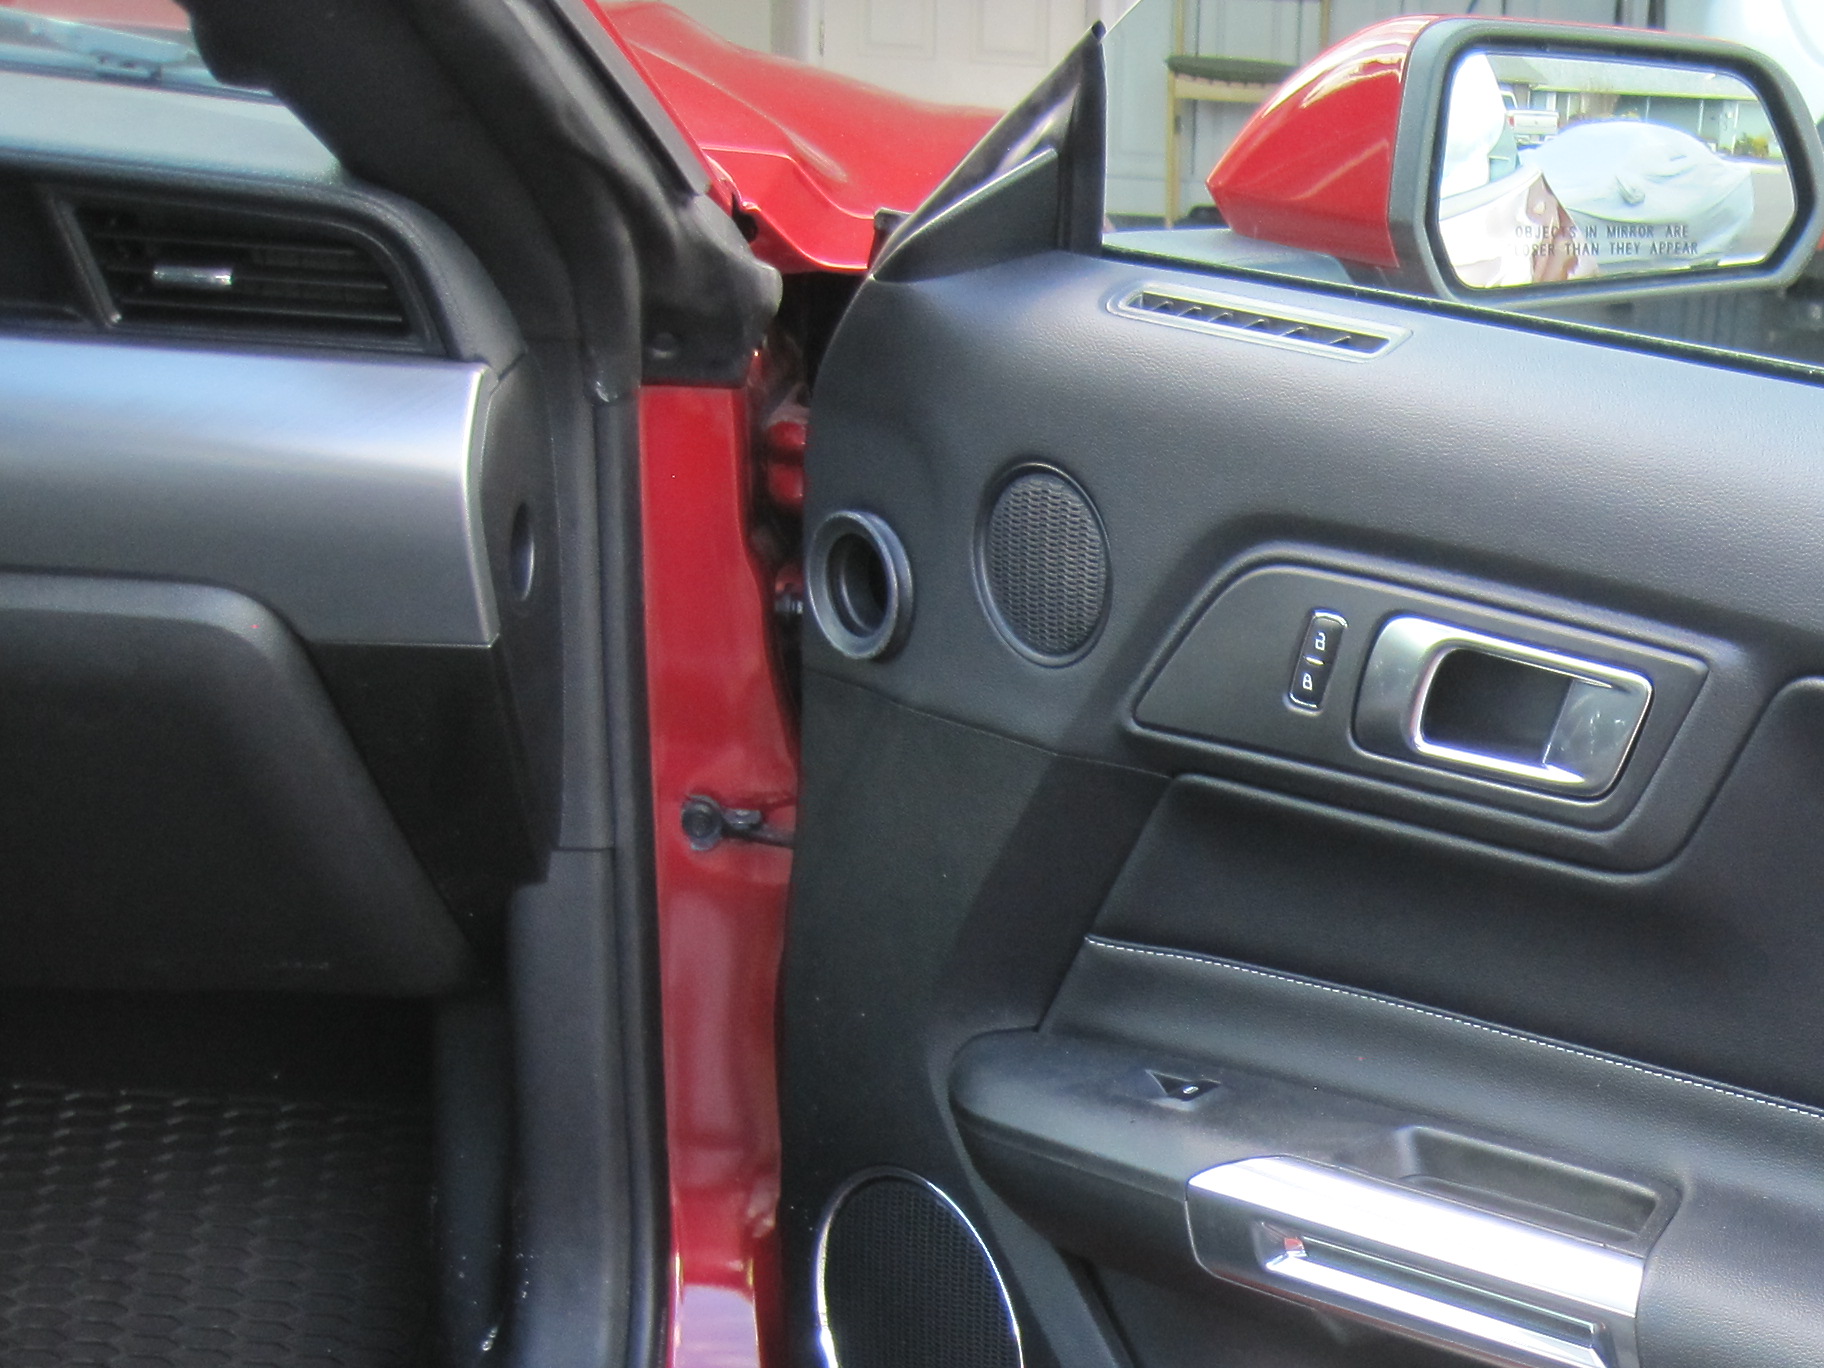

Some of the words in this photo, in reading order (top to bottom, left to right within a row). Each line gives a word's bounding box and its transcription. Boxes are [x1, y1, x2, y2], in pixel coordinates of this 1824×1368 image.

[1515, 225, 1576, 238] OBJECTS
[1585, 225, 1597, 238] IN
[1606, 225, 1654, 238] MIRROR
[1665, 225, 1689, 238] ARE
[1507, 243, 1556, 257] LOSER
[1564, 243, 1600, 256] THAN
[1609, 242, 1641, 255] THEY
[1650, 242, 1698, 254] APPEAR
